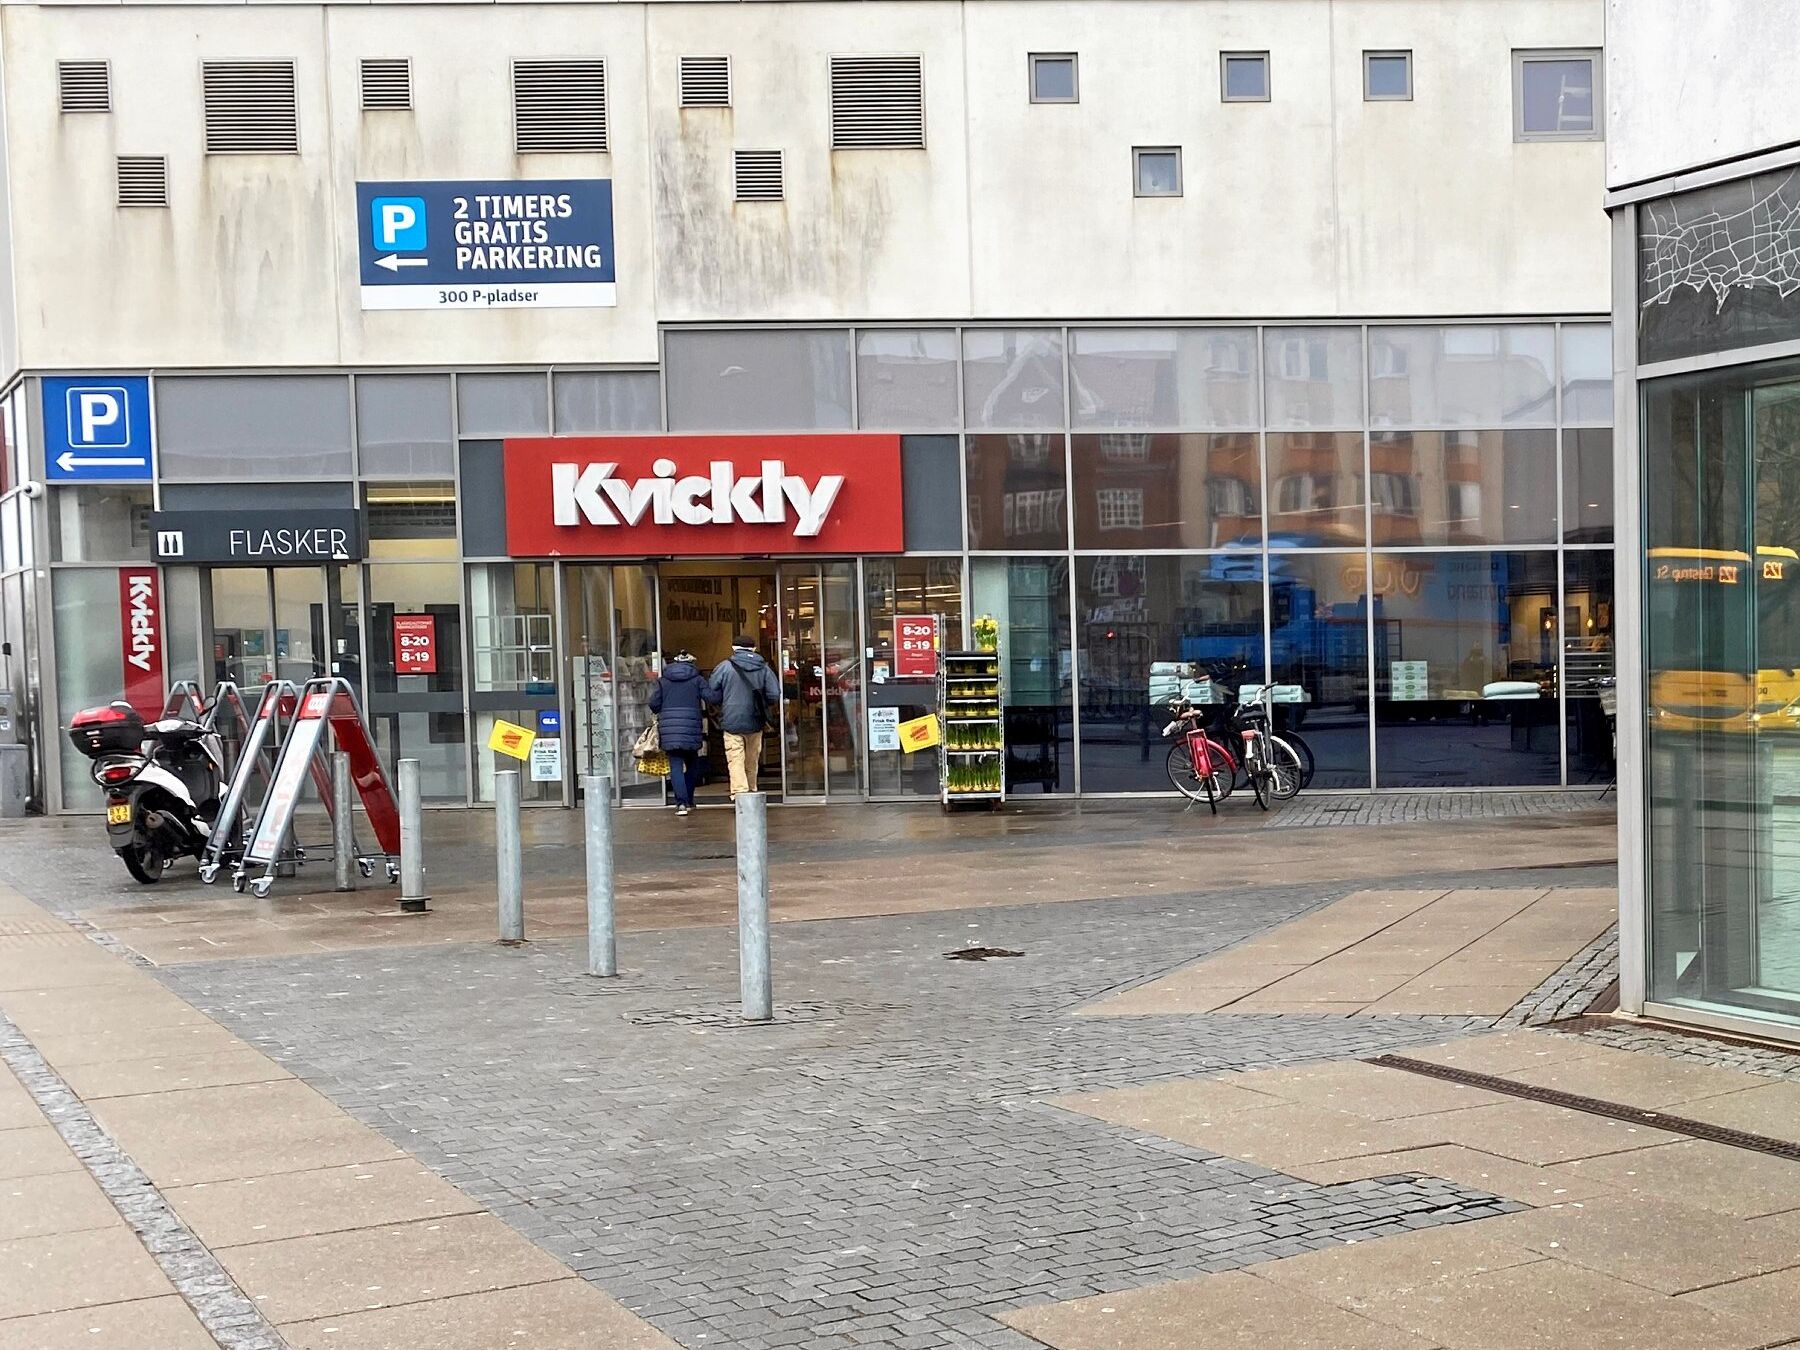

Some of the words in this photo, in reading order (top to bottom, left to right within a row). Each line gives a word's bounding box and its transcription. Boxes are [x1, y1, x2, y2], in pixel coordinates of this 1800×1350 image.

[453, 197, 469, 219] 2
[475, 194, 573, 219] TIMERS
[382, 204, 416, 244] P
[454, 220, 549, 245] GRATIS
[456, 245, 602, 270] PARKERING
[439, 290, 468, 303] 300
[472, 290, 539, 305] P-pladser
[80, 393, 119, 442] P
[551, 458, 846, 537] Kvickly
[229, 528, 348, 556] FLASKER
[128, 575, 155, 672] Kvickly
[903, 626, 931, 636] 8-20
[401, 636, 430, 646] 8-20
[903, 640, 931, 650] 8-19
[401, 651, 430, 662] 8-19
